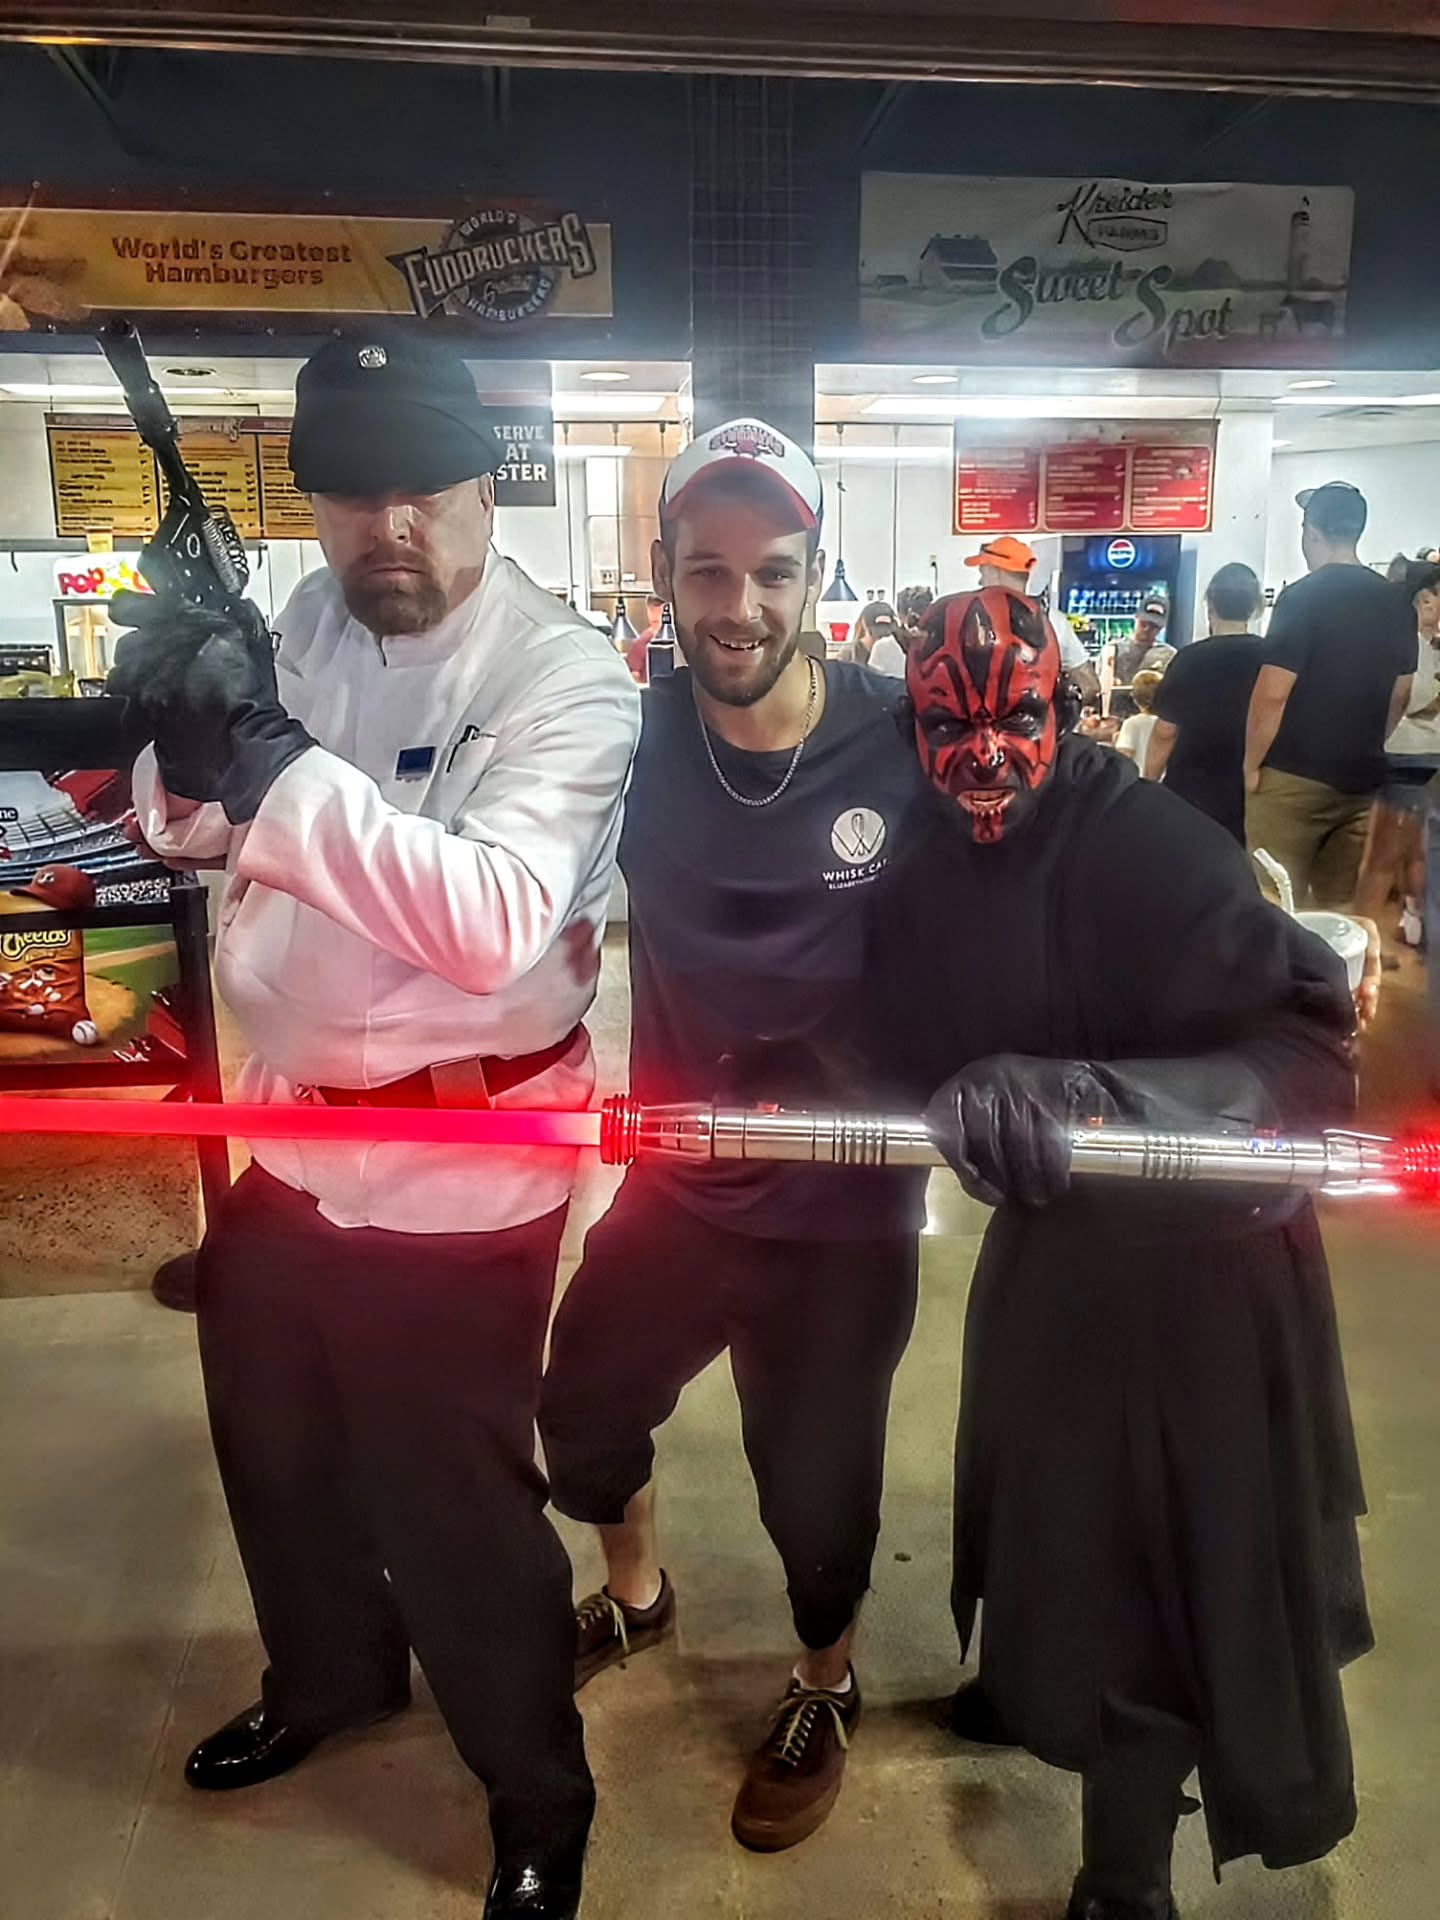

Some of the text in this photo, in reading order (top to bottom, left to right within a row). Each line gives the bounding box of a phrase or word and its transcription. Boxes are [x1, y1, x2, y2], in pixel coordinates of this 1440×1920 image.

[112, 236, 352, 262] World's Greatest
[145, 262, 324, 289] Hamburgers
[404, 212, 596, 319] FUDDRUCKERS
[980, 256, 1233, 354] Sweet Spot
[505, 443, 530, 460] AT
[496, 463, 548, 481] STER
[822, 867, 865, 881] WHISK
